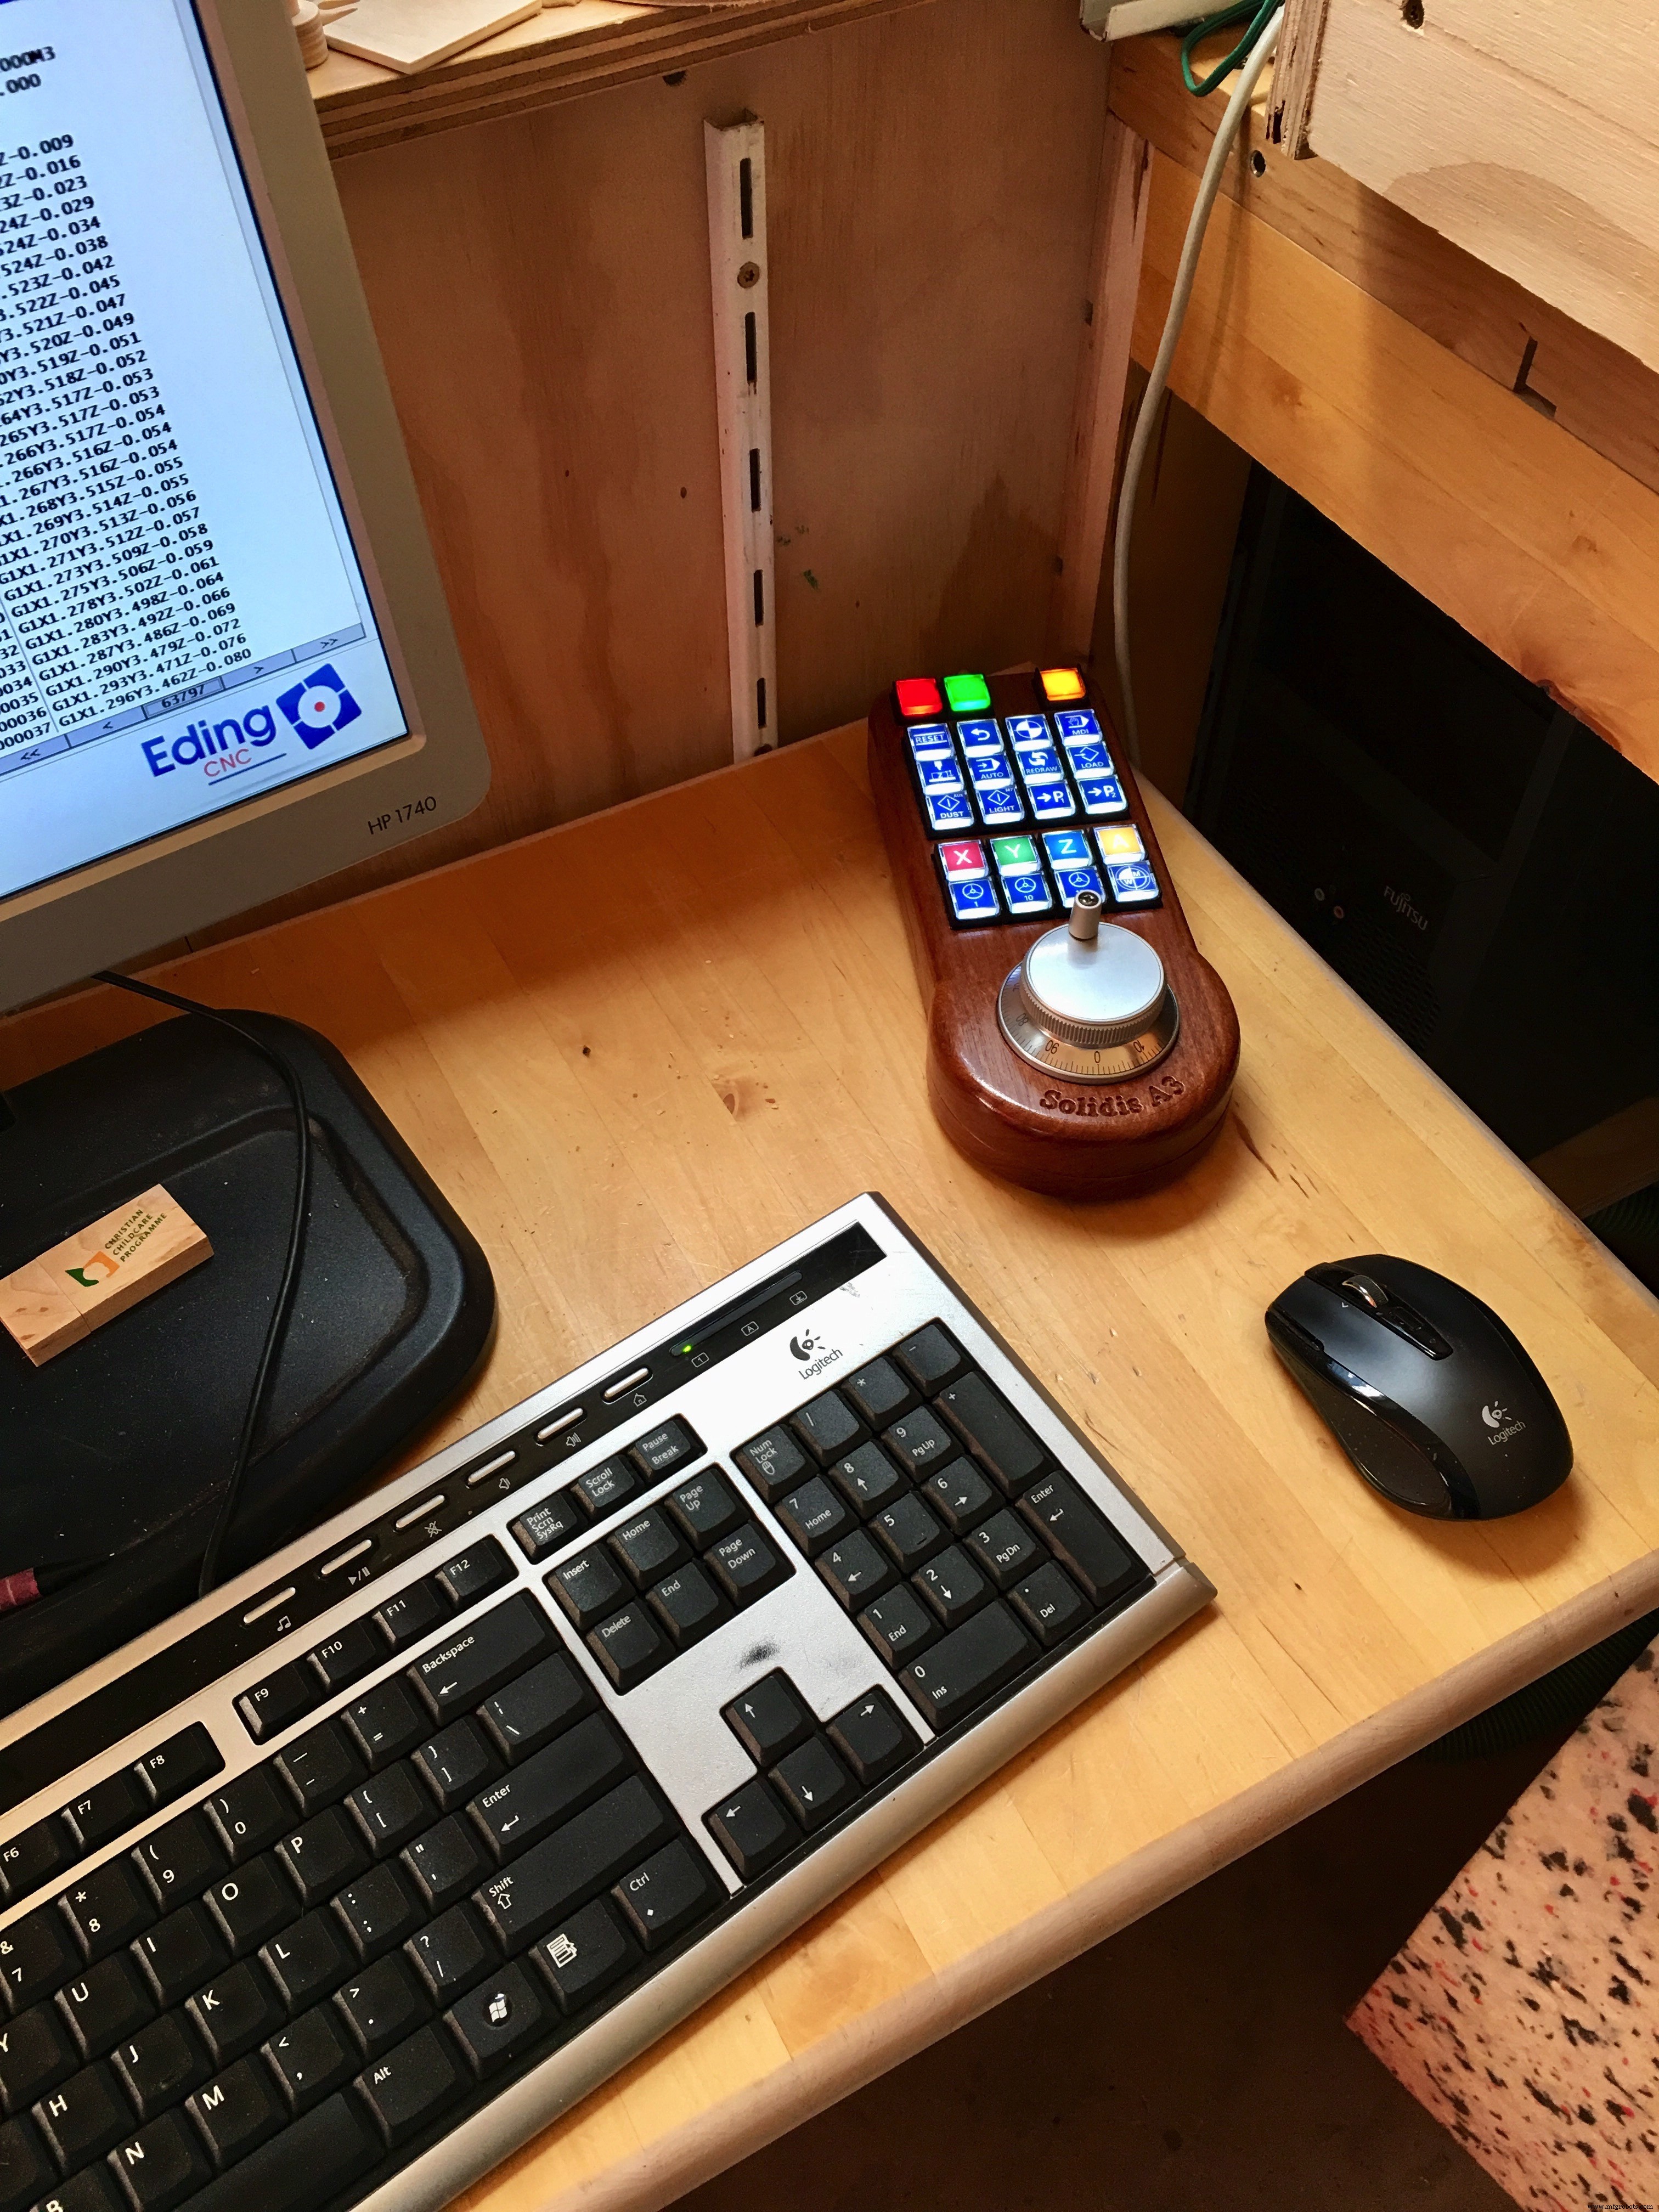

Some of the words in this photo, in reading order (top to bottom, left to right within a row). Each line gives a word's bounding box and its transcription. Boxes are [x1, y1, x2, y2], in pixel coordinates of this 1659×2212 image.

[161, 684, 205, 708] 63797
[140, 702, 277, 778] Eding
[916, 733, 945, 743] RESET
[203, 748, 252, 778] CNC
[1026, 766, 1058, 774] REDRAW
[367, 814, 392, 835] HP
[396, 795, 438, 825] 1740
[1113, 833, 1129, 849] A
[953, 849, 973, 866] X
[1005, 844, 1021, 859] Y
[1384, 885, 1429, 930] FUJITSU
[1133, 1040, 1145, 1053] 10
[1039, 1090, 1144, 1117] Solidis
[105, 1209, 144, 1250] CHRISTIAN
[112, 1214, 153, 1256] CHILDCARE
[120, 1212, 167, 1262] PROGRAMME
[798, 1348, 843, 1380] Logitech
[642, 1432, 668, 1451] Pause
[1487, 1421, 1526, 1446] Logitech
[652, 1444, 679, 1465] Break
[750, 1440, 772, 1456] Num
[756, 1448, 777, 1464] Lock
[912, 1439, 935, 1456] PgUp
[586, 1468, 612, 1488] Scroll
[592, 1480, 615, 1497] Lock
[680, 1485, 703, 1503] Page
[1031, 1485, 1054, 1504] Enter
[686, 1500, 701, 1511] Up
[526, 1508, 551, 1526] Print
[532, 1516, 553, 1533] Scrn
[805, 1509, 832, 1528] Home
[537, 1520, 564, 1539] SysRq
[622, 1519, 651, 1541] Home
[719, 1538, 742, 1556] Page
[996, 1543, 1020, 1563] PgDn
[450, 1559, 469, 1576] F12
[728, 1548, 756, 1569] Down
[563, 1560, 589, 1579] Insert
[662, 1580, 681, 1597] End
[386, 1600, 407, 1617] F11
[1040, 1604, 1056, 1618] Del
[602, 1615, 631, 1638] Delete
[888, 1626, 906, 1641] End
[322, 1641, 342, 1658] F10
[422, 1635, 475, 1673] Backspace
[255, 1689, 268, 1701] F9
[933, 1686, 947, 1699] Ins
[150, 1756, 165, 1768] F8
[482, 1784, 510, 1808] Enter
[78, 1800, 91, 1814] F7
[3, 1847, 19, 1861] F6
[489, 1876, 514, 1897] Shift
[629, 1873, 649, 1892] Ctrl
[374, 2065, 391, 2084] Alt
